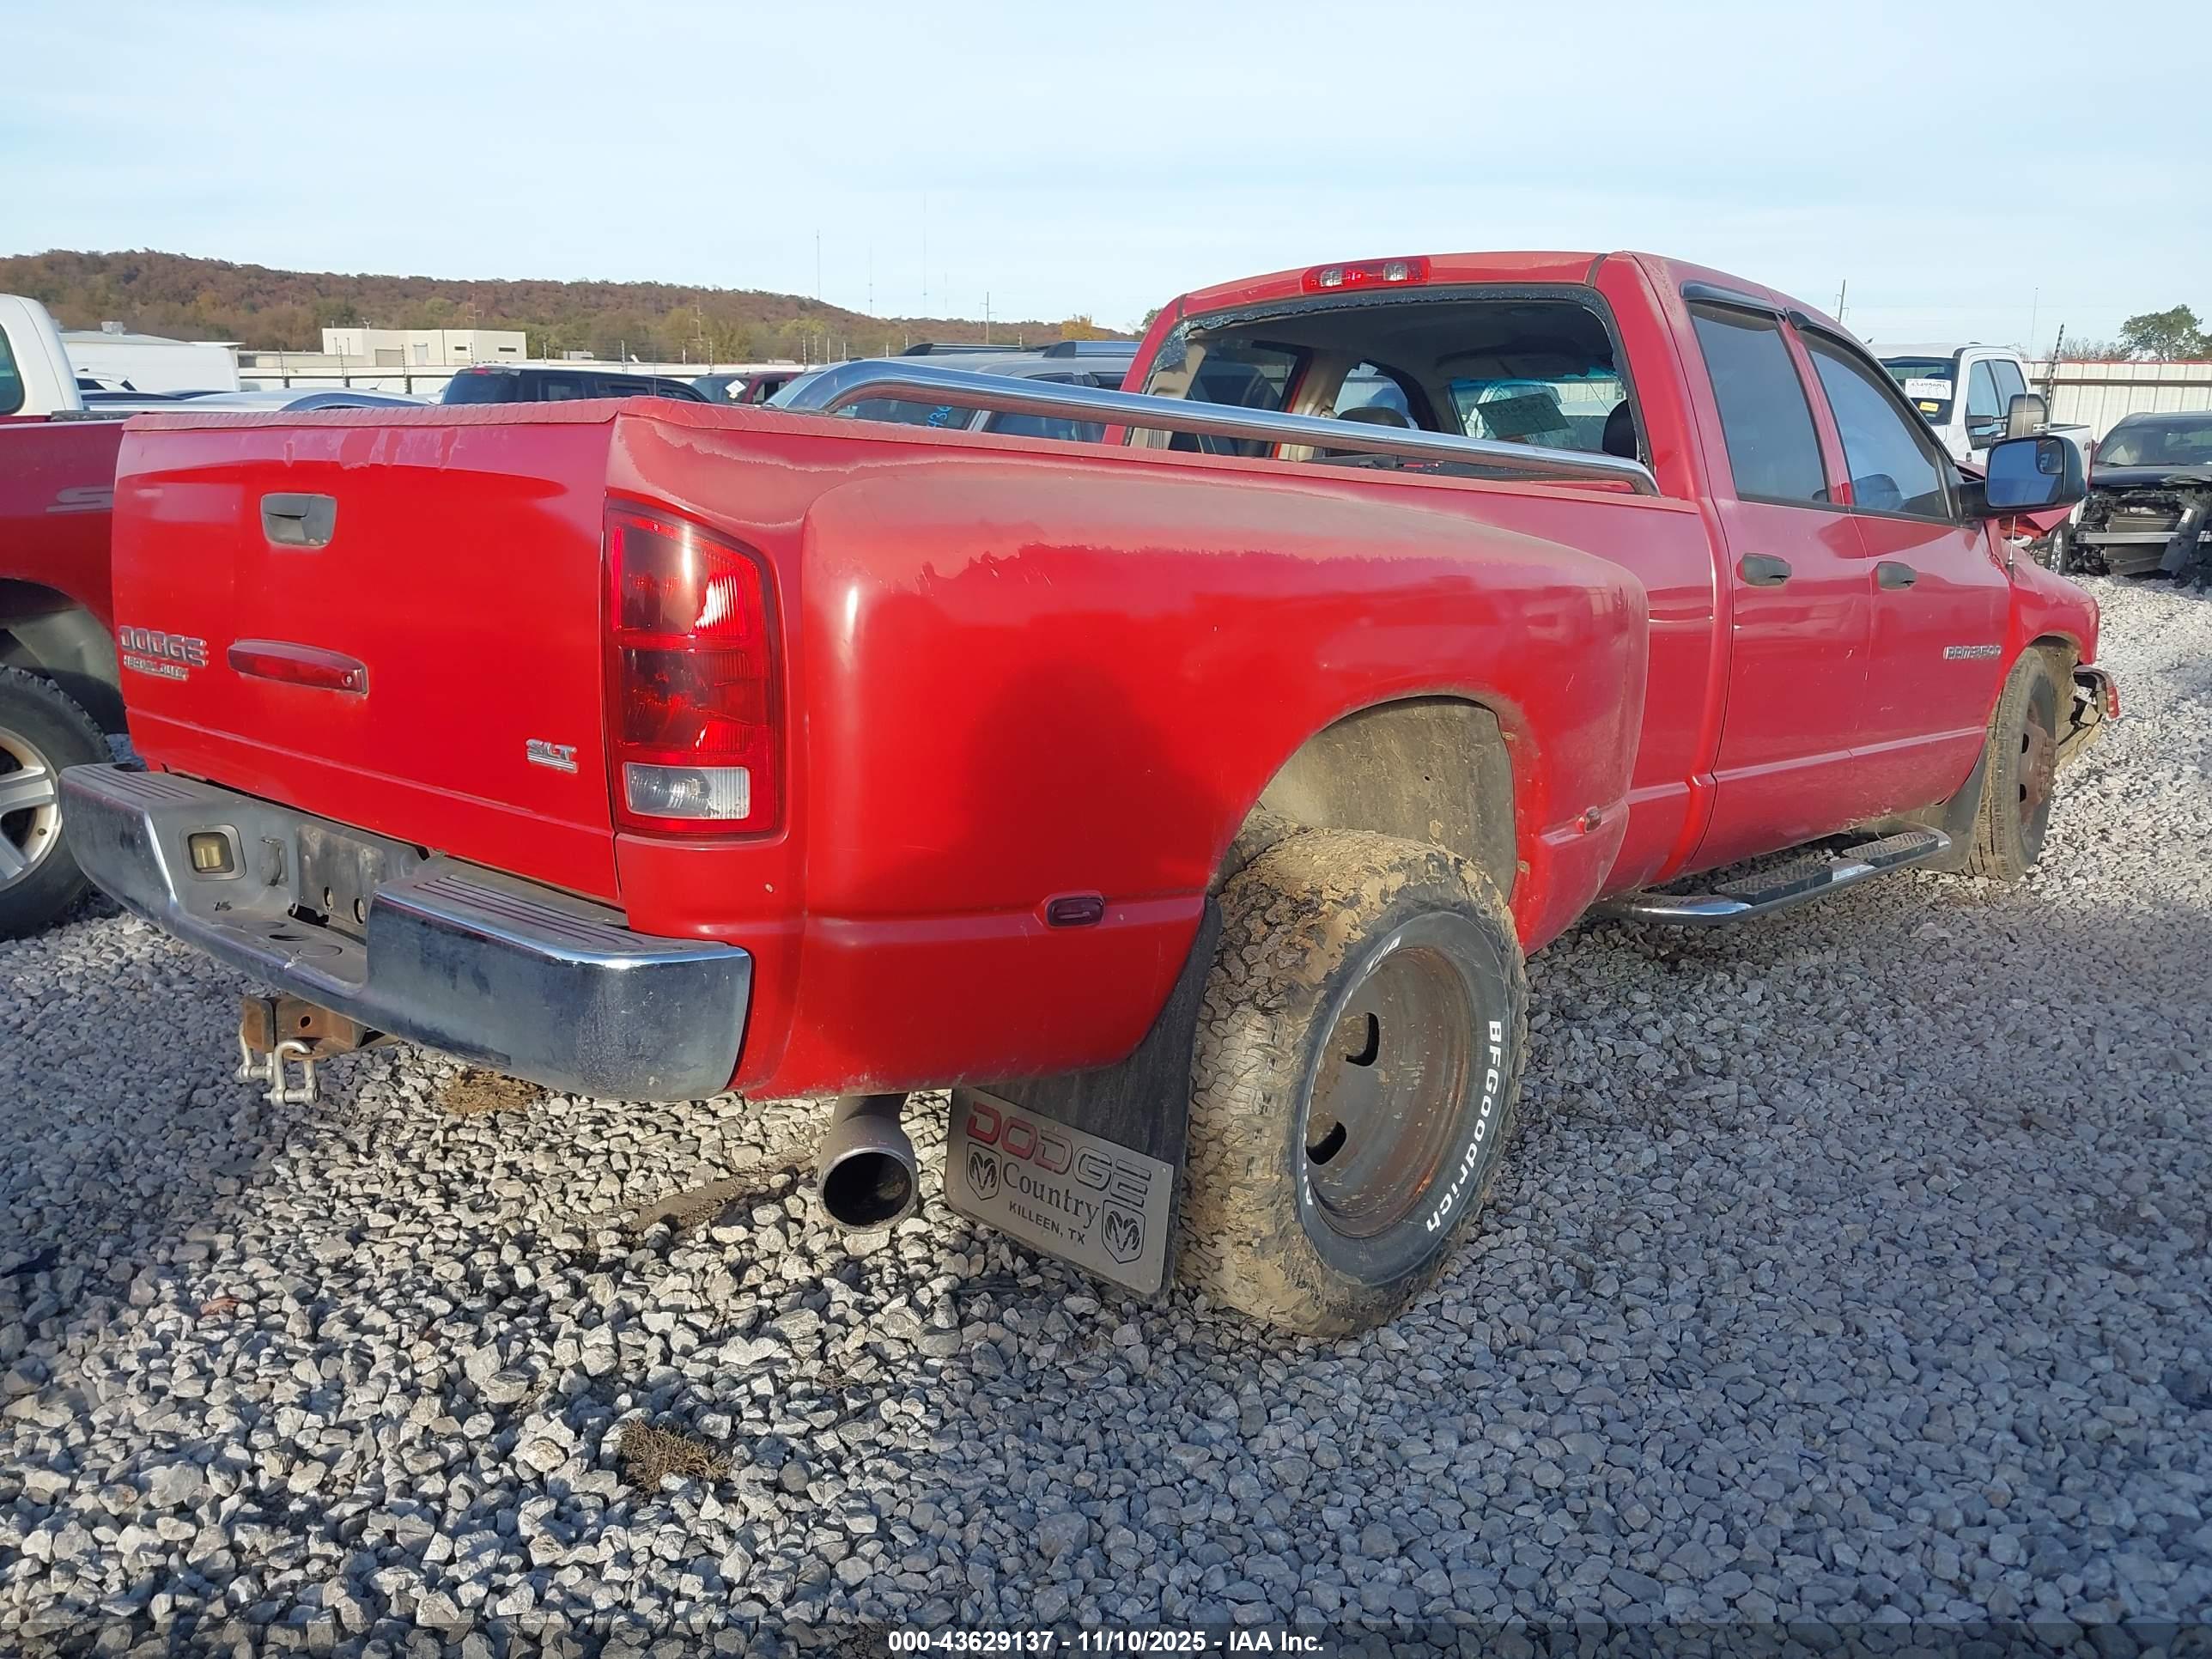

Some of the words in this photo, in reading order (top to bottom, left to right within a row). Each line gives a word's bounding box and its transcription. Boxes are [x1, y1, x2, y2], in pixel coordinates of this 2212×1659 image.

[119, 625, 210, 666] DODGE
[526, 738, 577, 763] SLT
[966, 1101, 1152, 1208] DODGE
[1003, 1162, 1100, 1229] Country
[1009, 1200, 1064, 1237] KILLEEN,
[1067, 1227, 1086, 1245] TX
